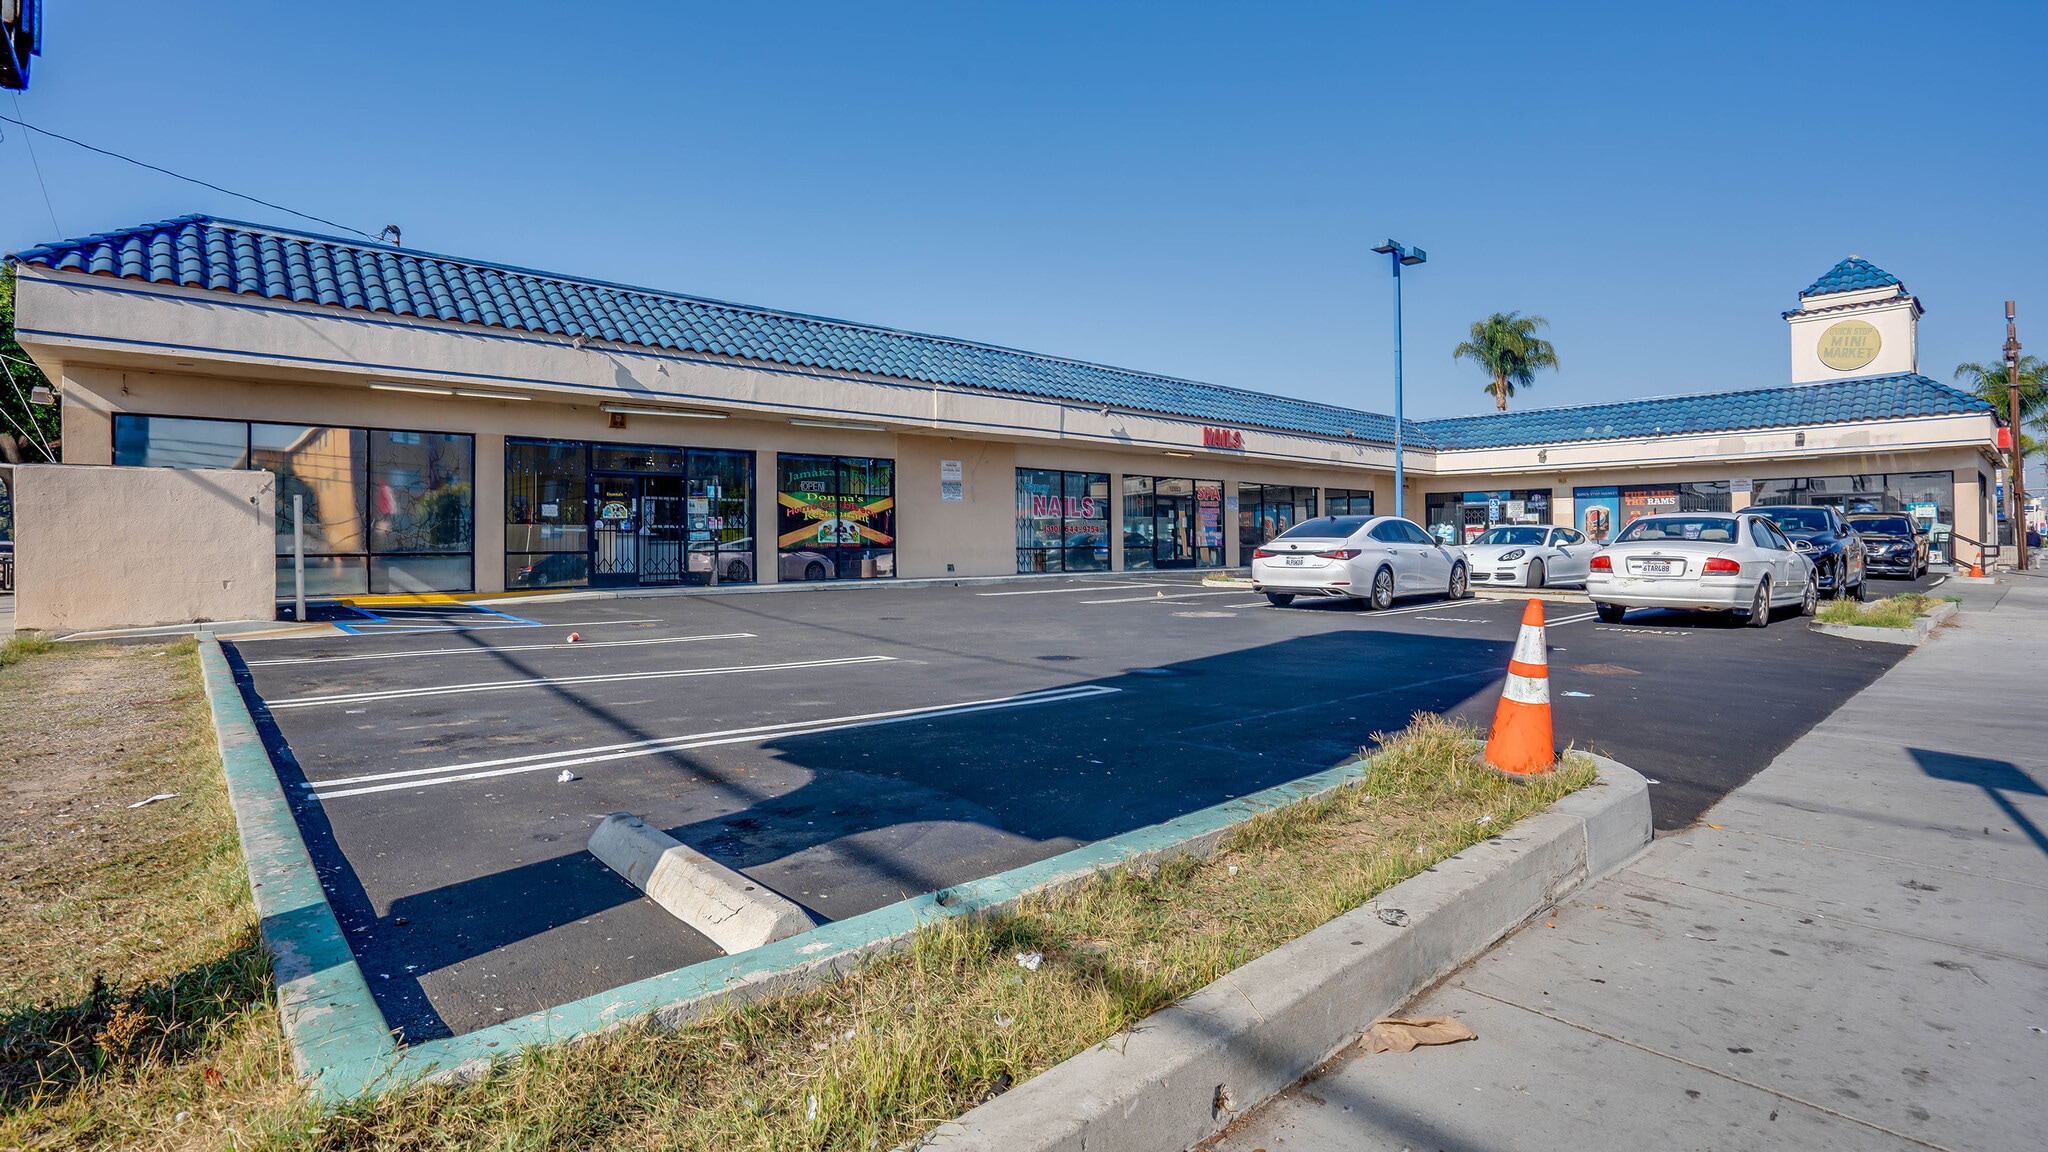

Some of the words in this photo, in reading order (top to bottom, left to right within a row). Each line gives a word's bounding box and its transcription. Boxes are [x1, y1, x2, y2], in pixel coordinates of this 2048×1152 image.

[1829, 327, 1853, 336] QUICK
[1854, 327, 1873, 336] STOP
[1831, 336, 1867, 347] MINI
[1823, 347, 1874, 359] MARKET
[1203, 426, 1242, 449] NAILS
[788, 468, 847, 484] Jamaican
[801, 481, 825, 492] OPEN
[806, 492, 864, 502] Donna's
[1197, 485, 1220, 501] SPA
[1651, 490, 1675, 498] LIKE
[1033, 494, 1095, 519] NAILS
[1625, 497, 1645, 506] THE
[1647, 497, 1676, 506] RAMS
[786, 503, 818, 518] Home
[820, 500, 878, 519] Caibbean
[1043, 525, 1060, 534] (310)
[1064, 525, 1100, 533] 644-9754
[1595, 627, 1693, 635] COMPACT
